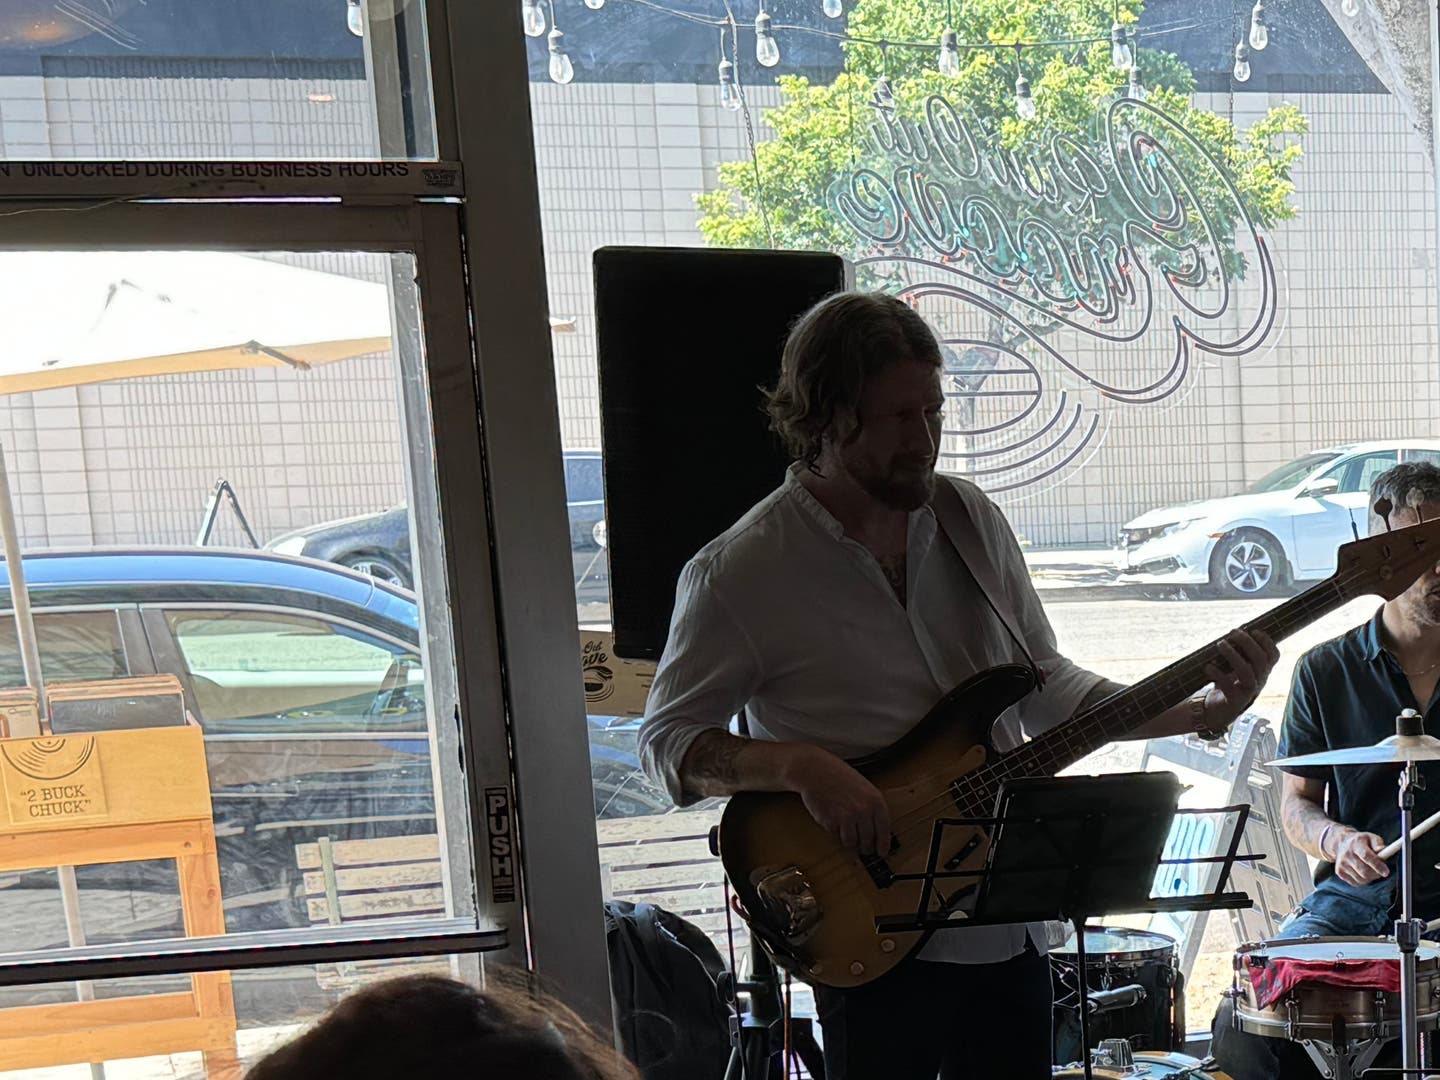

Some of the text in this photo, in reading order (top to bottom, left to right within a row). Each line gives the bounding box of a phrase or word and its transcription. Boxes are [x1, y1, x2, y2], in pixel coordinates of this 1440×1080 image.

[22, 163, 140, 177] UNLOCKED
[145, 163, 225, 177] DURING
[231, 163, 333, 178] BUSINESS
[338, 162, 409, 177] HOURS
[41, 784, 86, 801] BUCK
[487, 793, 514, 878] PUSH
